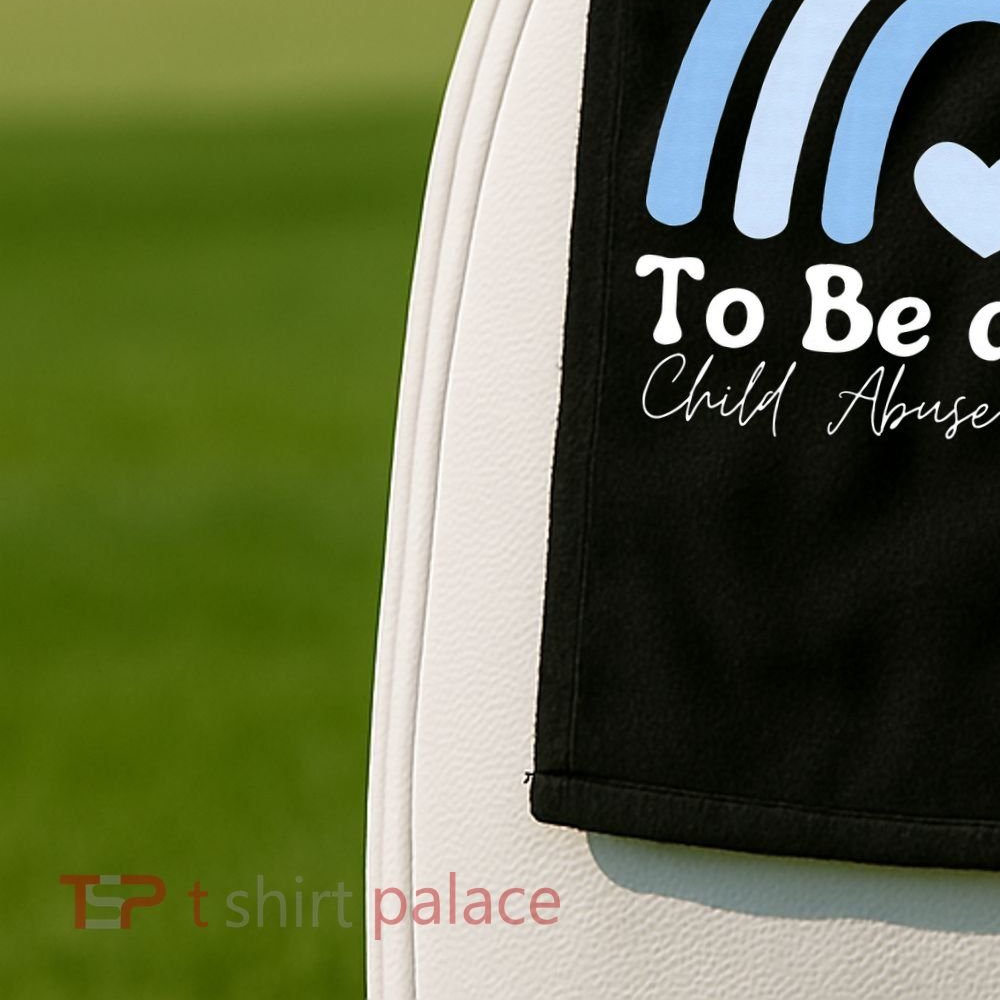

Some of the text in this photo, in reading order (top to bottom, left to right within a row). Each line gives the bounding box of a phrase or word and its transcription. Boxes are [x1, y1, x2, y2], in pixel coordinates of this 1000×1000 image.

[635, 254, 765, 349] To
[801, 263, 931, 358] Be
[641, 353, 797, 437] Child
